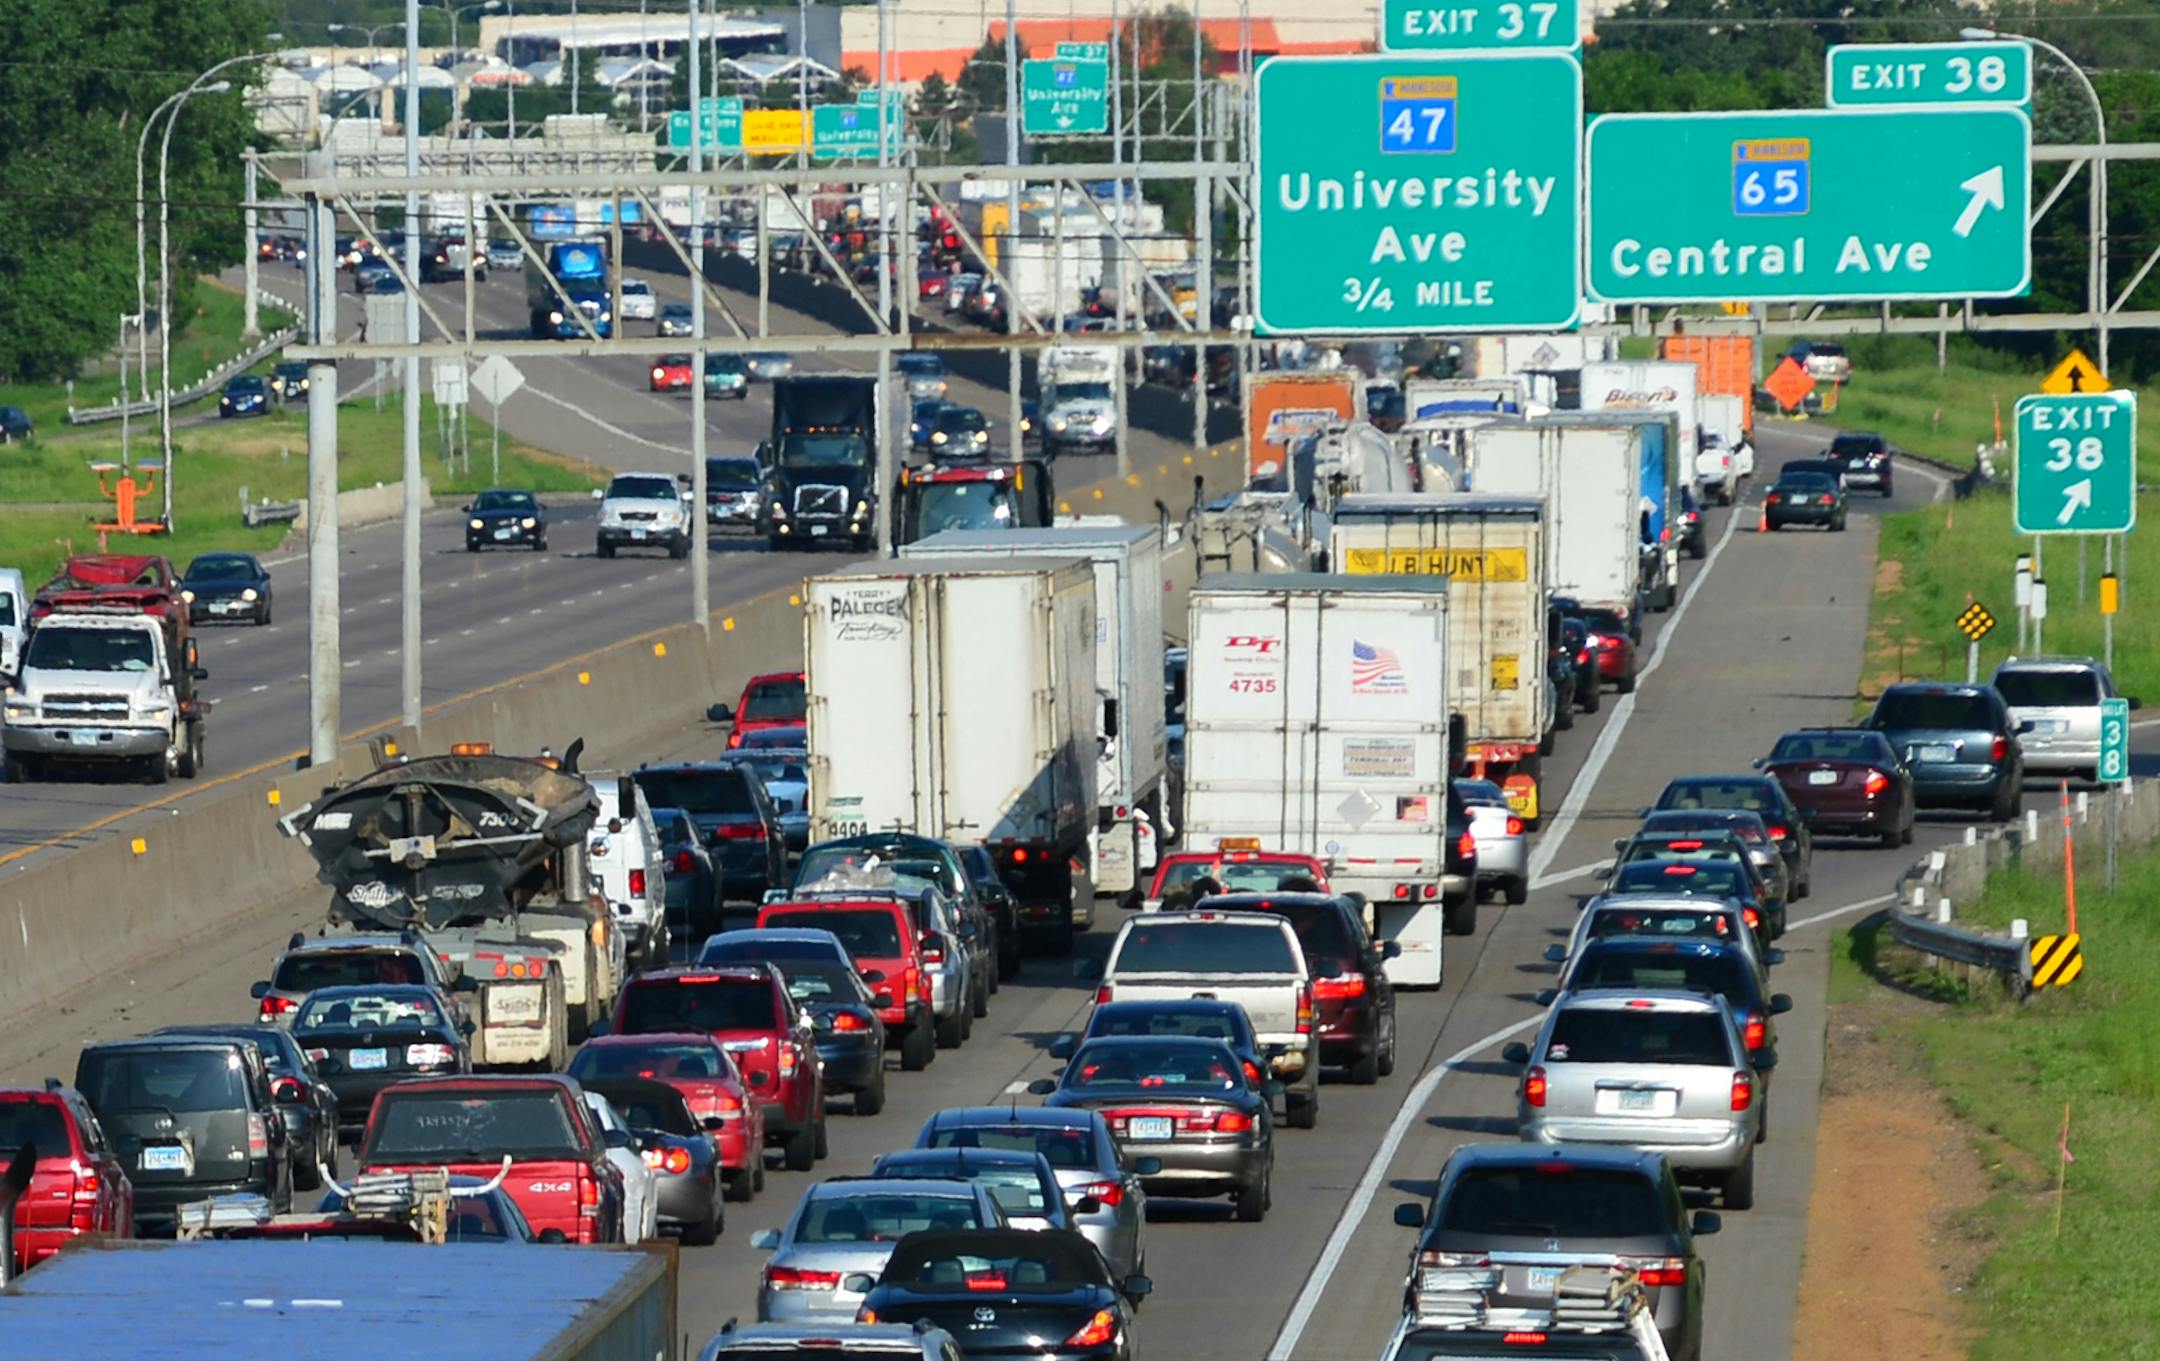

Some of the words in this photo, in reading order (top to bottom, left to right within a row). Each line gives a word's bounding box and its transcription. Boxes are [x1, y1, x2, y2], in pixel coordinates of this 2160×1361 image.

[1404, 9, 1478, 36] EXIT
[1497, 3, 1558, 38] 37
[1851, 63, 1926, 90] EXIT
[1945, 56, 2007, 93] 38
[1027, 87, 1102, 101] University
[1388, 107, 1447, 144] 47
[1279, 168, 1556, 216] University
[1742, 169, 1799, 205] 65
[1370, 225, 1467, 265] Ave
[1611, 237, 1805, 277] Central
[1835, 235, 1933, 274] Ave
[1416, 281, 1494, 308] MILE
[2032, 405, 2117, 431] EXIT
[2044, 436, 2104, 471] 38
[1429, 556, 1487, 576] HUNT
[1229, 679, 1277, 693] 4735
